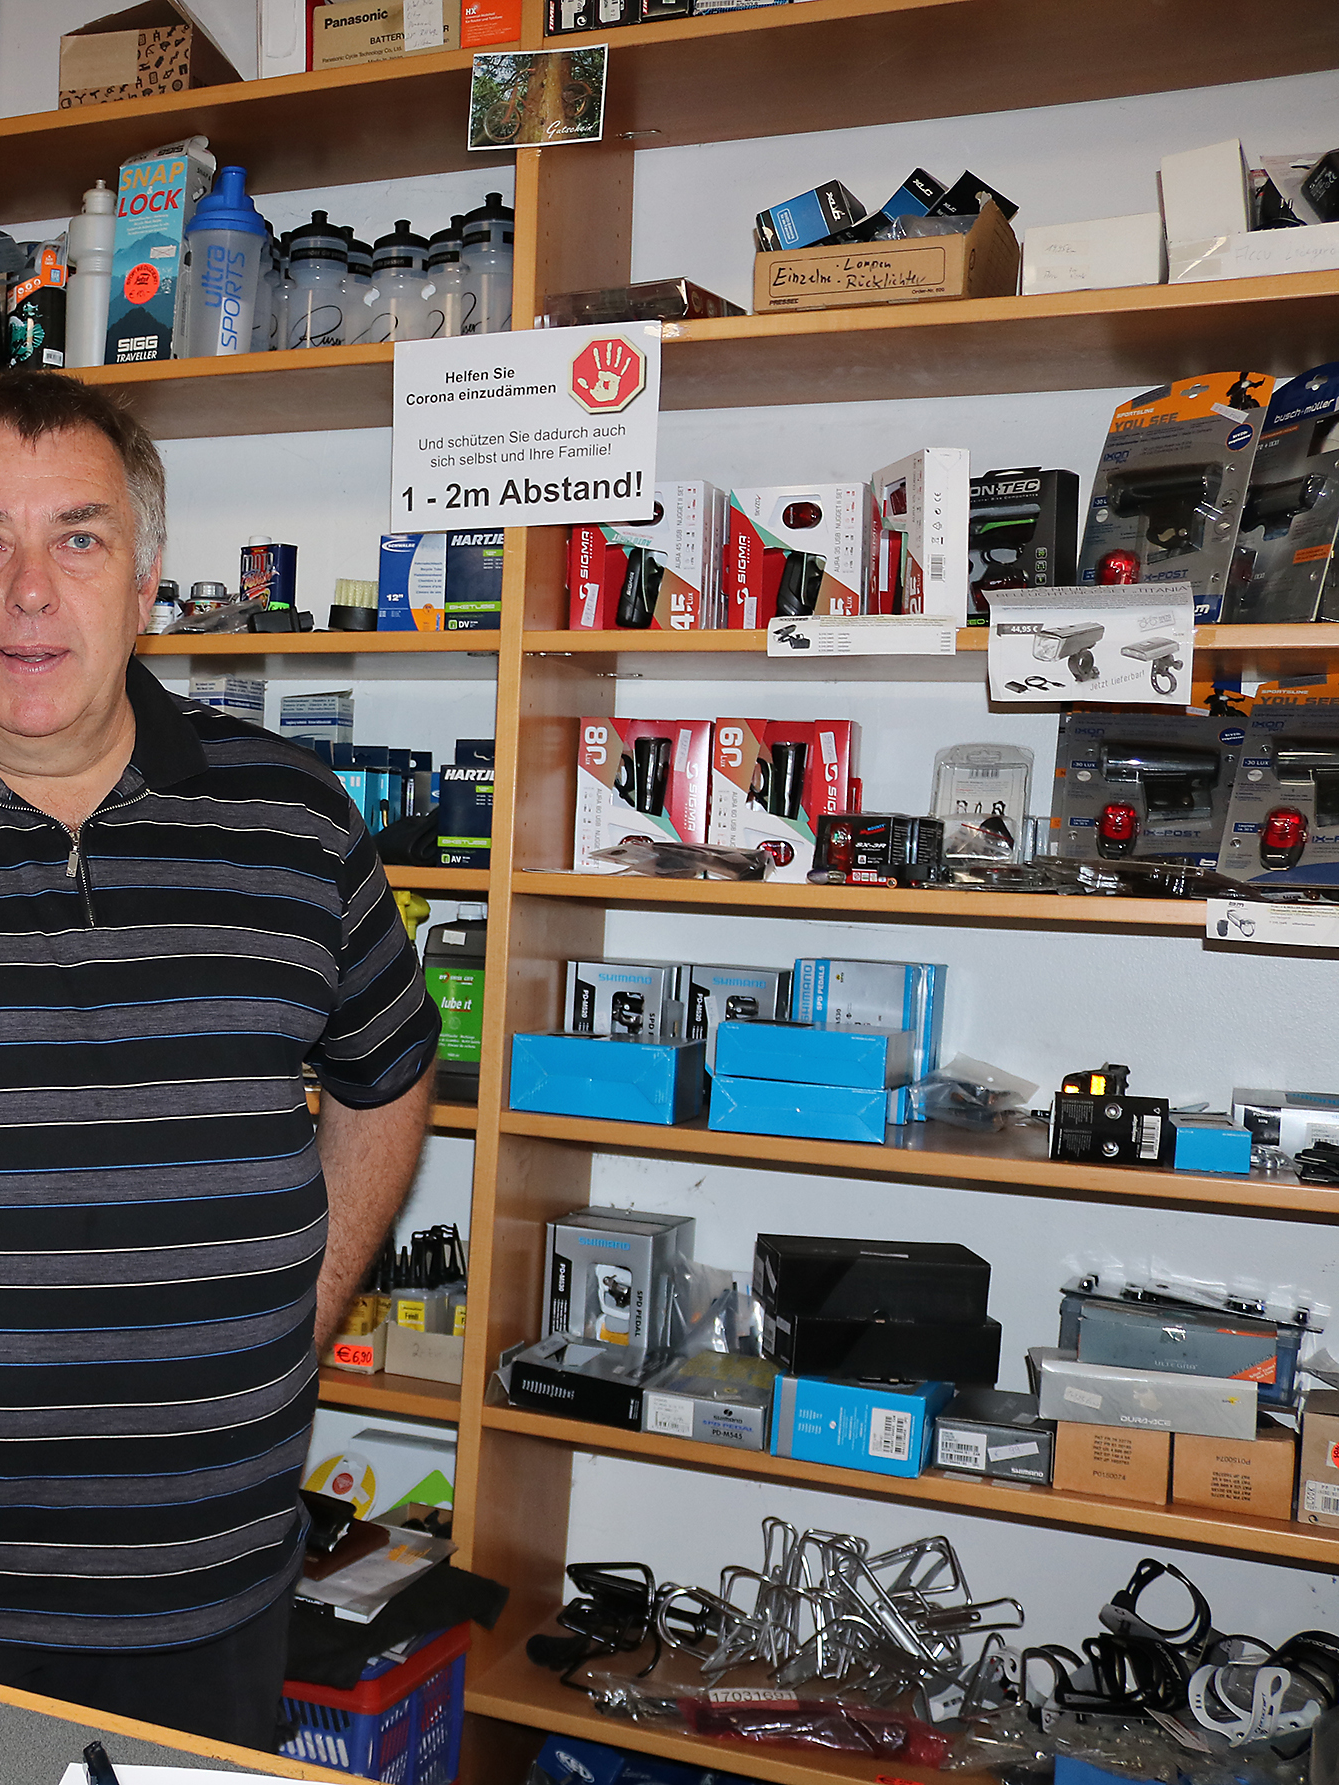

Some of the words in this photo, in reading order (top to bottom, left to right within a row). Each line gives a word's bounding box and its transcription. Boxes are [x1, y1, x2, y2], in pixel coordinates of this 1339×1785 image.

[324, 8, 389, 29] Panasonic
[465, 8, 476, 16] HX
[370, 32, 405, 45] BATTERY
[359, 49, 383, 58] Technology
[546, 119, 599, 140] Gutschein
[120, 161, 185, 192] SNAP
[146, 186, 154, 194] &
[912, 178, 934, 197] XLC
[118, 188, 183, 218] LOCK
[202, 244, 226, 309] ultra
[221, 250, 246, 350] SPORTS
[117, 335, 159, 354] SIGG
[116, 350, 158, 364] TRAVELLER
[445, 368, 490, 385] Helfen
[493, 367, 515, 381] Sie
[406, 389, 455, 407] Corona
[458, 382, 557, 403] einzudämmen
[1116, 407, 1155, 420] SPORTSLINE
[1145, 411, 1180, 429] SEE
[418, 437, 444, 452] Und
[447, 431, 505, 450] schützen
[508, 429, 530, 444] Sie
[533, 425, 589, 442] dadurch
[592, 423, 626, 438] auch
[430, 454, 455, 469] sich
[459, 451, 497, 467] selbst
[500, 449, 525, 463] und
[529, 447, 554, 461] Ihre
[558, 443, 612, 459] Familie!
[402, 485, 414, 512] 1
[444, 483, 491, 510] 2m
[499, 470, 643, 507] Abstand!
[676, 502, 684, 526] NUGGET
[834, 505, 842, 530] NUGGET
[451, 533, 504, 547] HARTJE
[675, 529, 683, 542] USB
[834, 532, 842, 545] USB
[580, 530, 590, 580] SIGMA
[675, 542, 682, 552] 45
[834, 545, 841, 555] 35
[737, 534, 748, 585] SIGMA
[833, 555, 841, 573] AURA
[670, 593, 686, 630] 45
[458, 620, 470, 629] DV
[1011, 624, 1032, 634] 44,95
[1090, 678, 1109, 692] Jetzt
[1110, 670, 1146, 687] lieferbar!
[688, 782, 697, 832] SIGMA
[1143, 829, 1201, 838] IX-POST
[451, 855, 462, 863] AV
[598, 972, 653, 986] SHIMANO
[712, 976, 767, 989] SHIMANO
[816, 965, 826, 995] PEDALS
[801, 964, 813, 1023] SHIMANO
[441, 996, 462, 1010] lube
[463, 996, 472, 1010] it
[581, 989, 591, 1022] PD-M520
[816, 995, 825, 1012] SPD
[578, 1235, 631, 1251] SHIMANO
[636, 1289, 644, 1310] SPD
[634, 1310, 644, 1338] PEDAL
[713, 1414, 743, 1425] SHIMANO
[1120, 1414, 1173, 1428] DURA-ACE
[712, 1428, 744, 1441] PD-M545
[1011, 1467, 1044, 1479] SHIMANO
